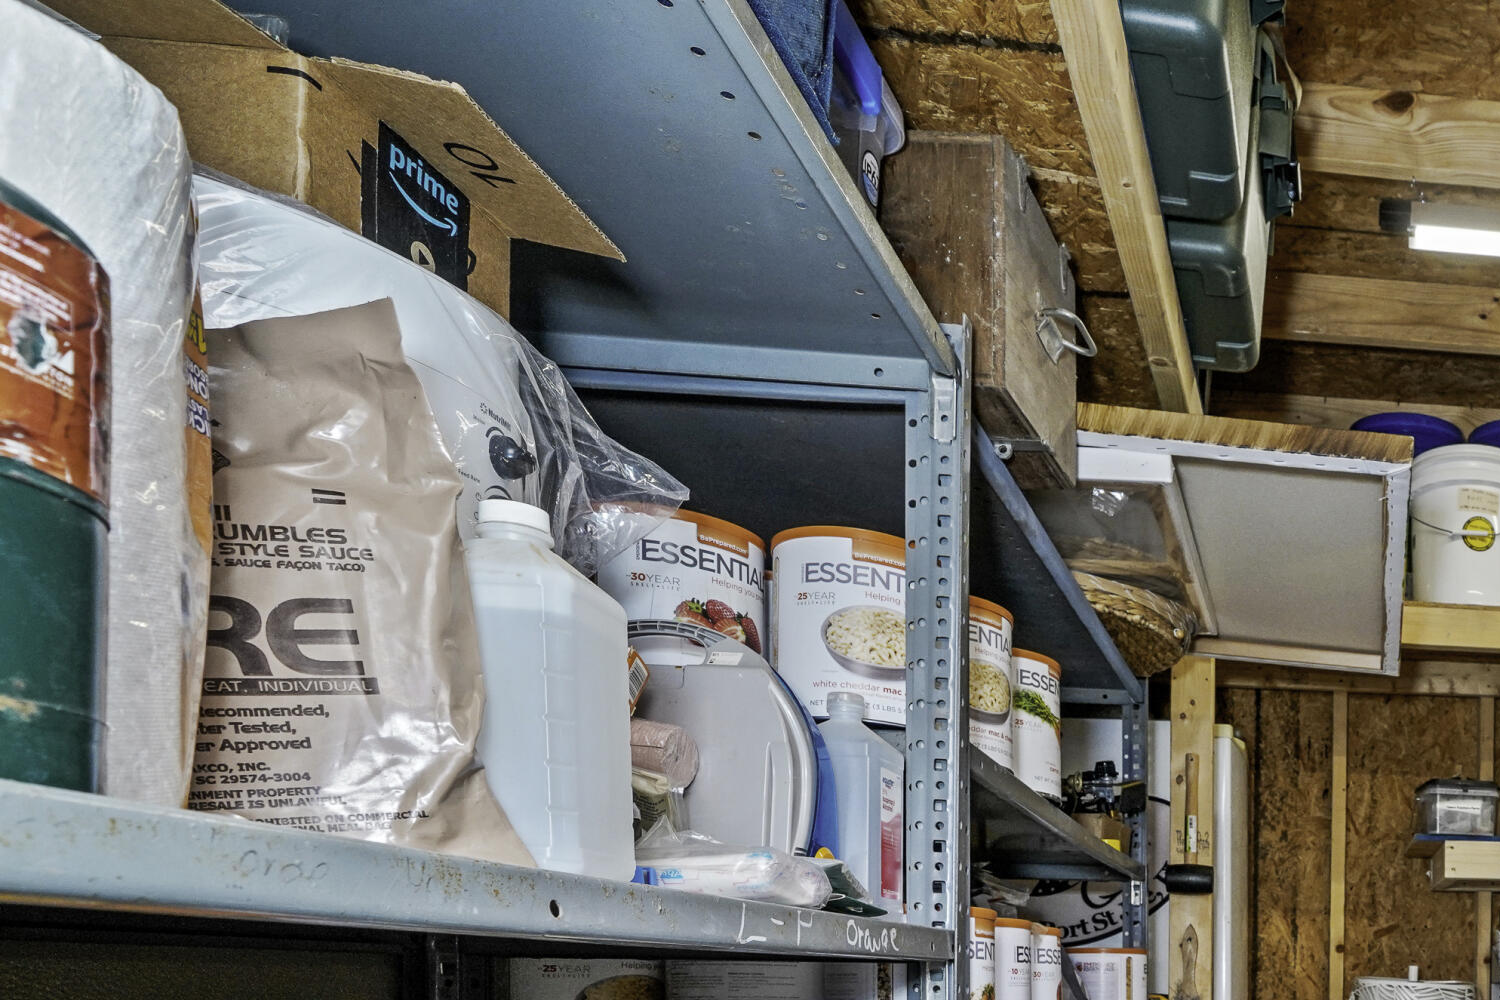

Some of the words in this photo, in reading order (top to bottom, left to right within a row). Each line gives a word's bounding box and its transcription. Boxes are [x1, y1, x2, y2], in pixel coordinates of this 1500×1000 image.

[388, 143, 459, 216] prime
[218, 543, 289, 557] STYLE
[298, 545, 375, 561] SAUCE
[223, 558, 272, 568] SAUCE
[276, 561, 322, 572] FAÇON
[329, 562, 366, 573] TACO)
[711, 576, 743, 595] Helping
[864, 591, 901, 605] Helping
[258, 680, 373, 693] INDIVIDUAL
[812, 679, 838, 688] white
[840, 680, 880, 693] cheddar
[882, 687, 902, 696] mac
[229, 721, 298, 735] Tested,
[218, 737, 312, 754] Approved
[237, 762, 271, 772] INC.
[195, 775, 217, 785] SC
[220, 772, 312, 784] 29574-3004
[246, 786, 321, 799] PROPERTY
[188, 801, 245, 811] RESALE
[248, 800, 265, 809] IS
[267, 795, 347, 809] UNLAWFUL
[621, 961, 655, 970] Helping
